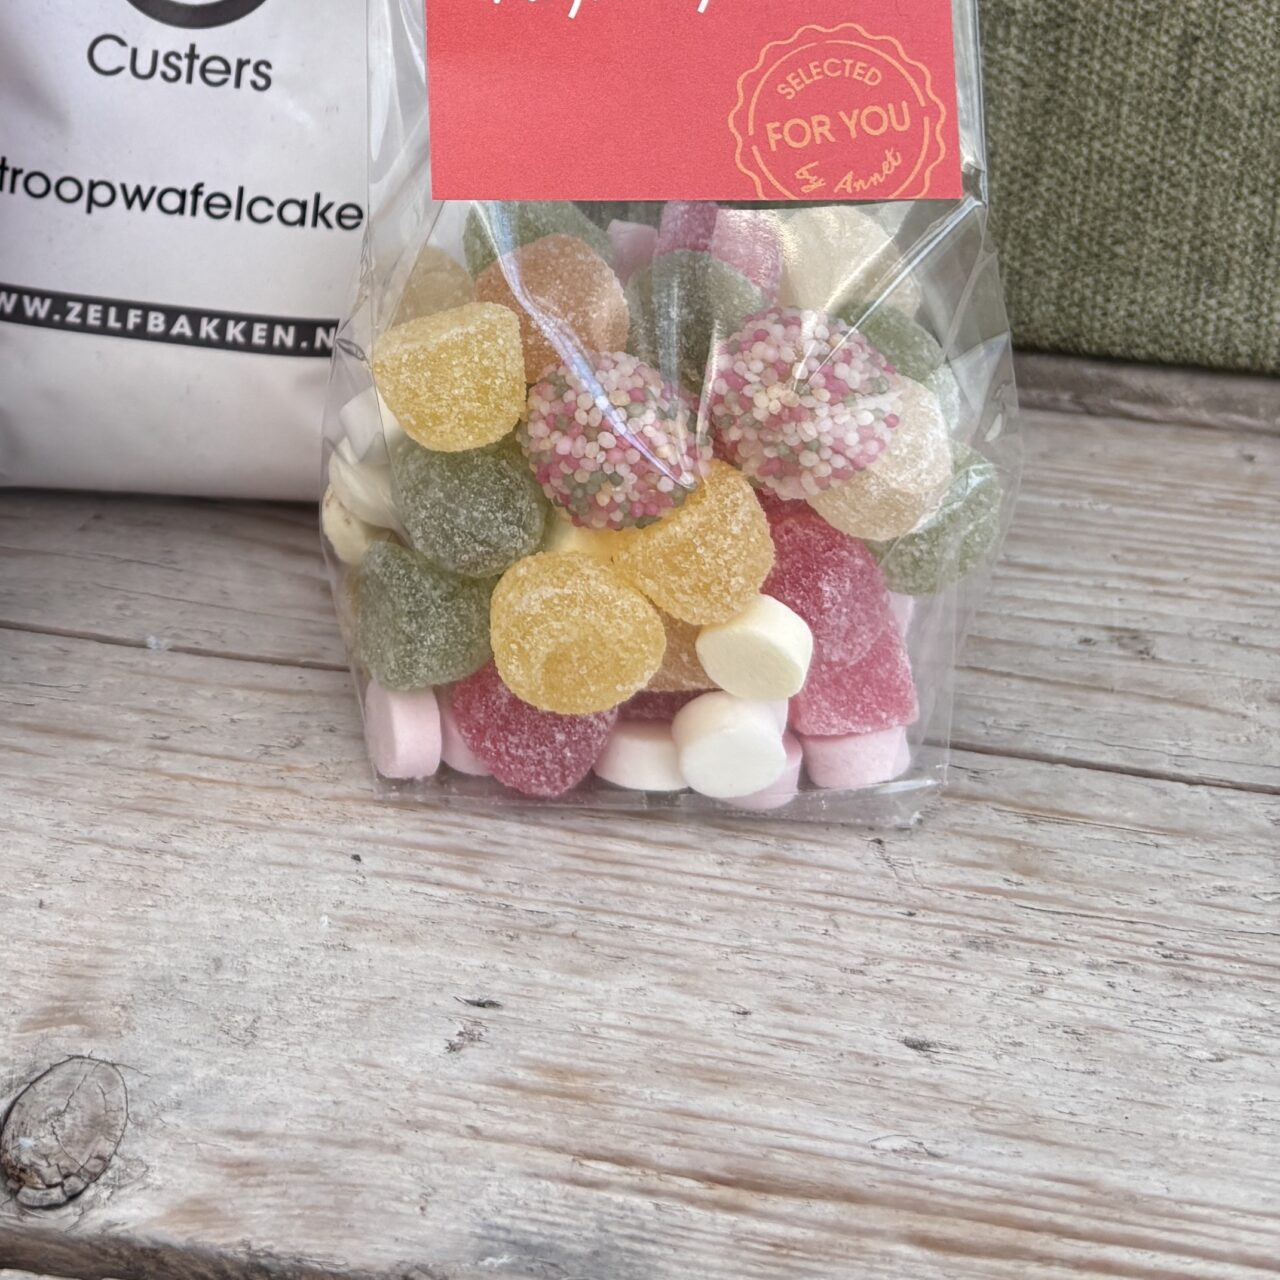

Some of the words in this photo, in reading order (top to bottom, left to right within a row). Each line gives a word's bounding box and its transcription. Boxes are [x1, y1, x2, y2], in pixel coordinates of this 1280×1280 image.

[86, 33, 273, 92] Custers
[776, 58, 883, 101] SELECTED
[766, 115, 836, 152] FOR
[839, 100, 911, 139] YOU
[833, 147, 902, 194] Annet
